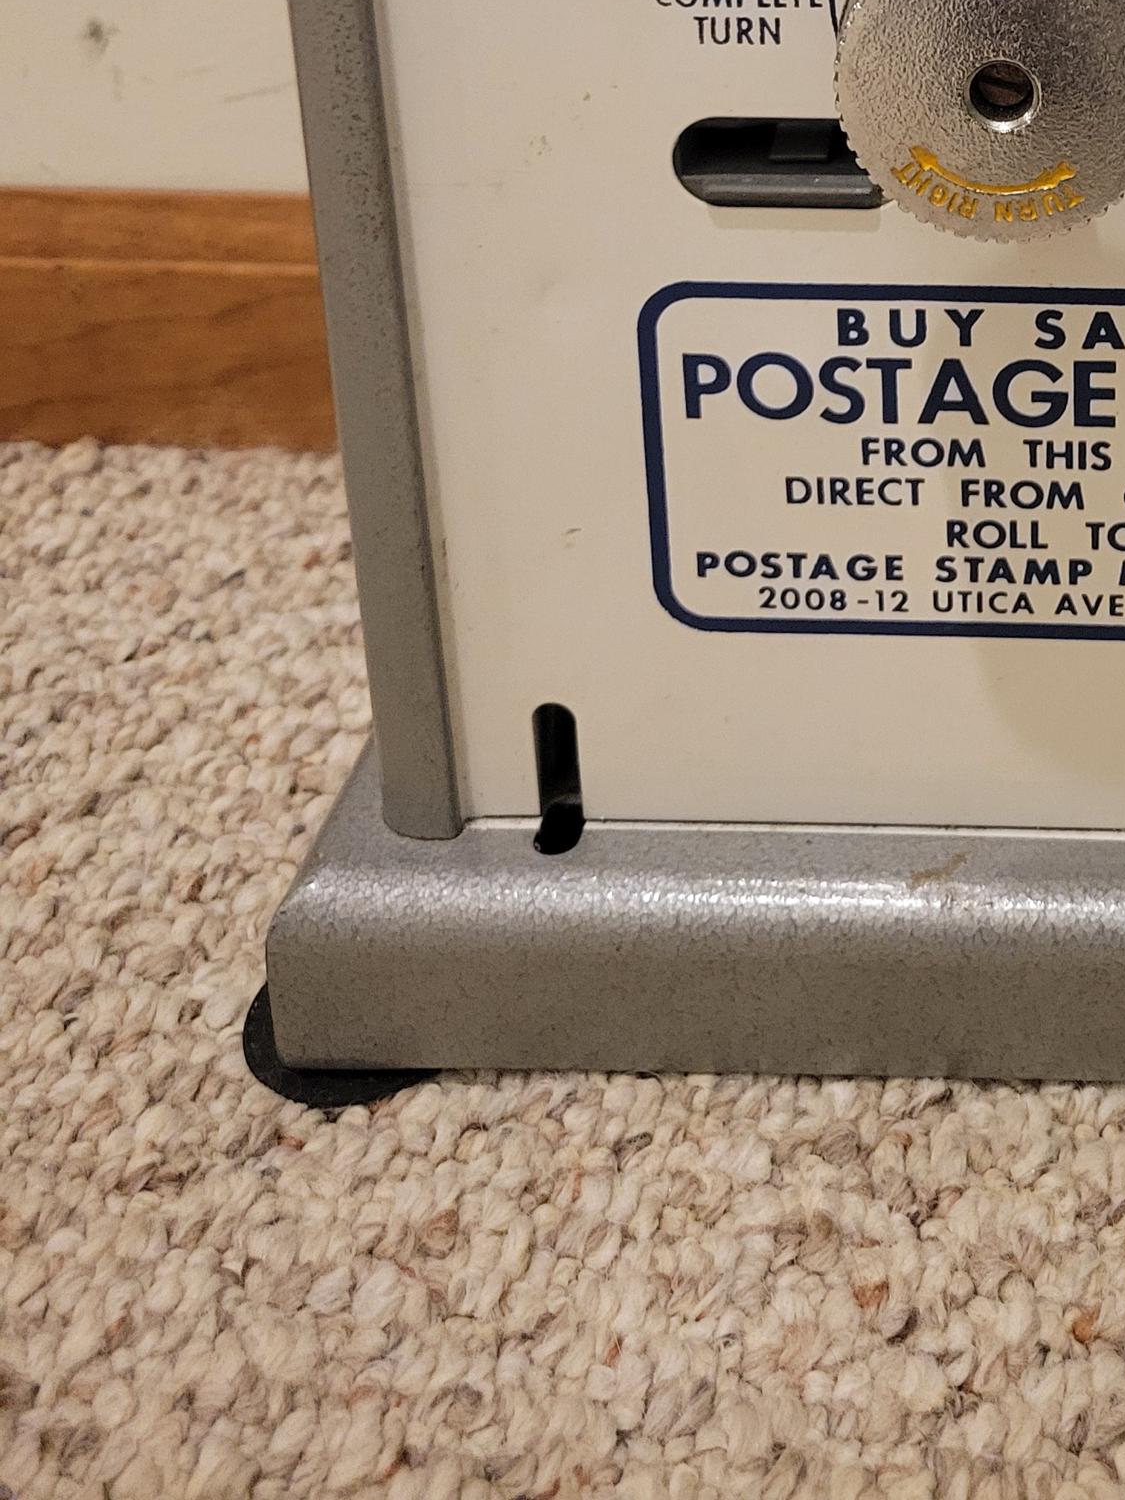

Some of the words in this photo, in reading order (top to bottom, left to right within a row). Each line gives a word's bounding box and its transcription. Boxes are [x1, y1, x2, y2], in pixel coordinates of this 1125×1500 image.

[693, 16, 780, 45] TURN
[890, 162, 979, 219] RIGHT
[995, 185, 1086, 222] TURN
[837, 308, 985, 348] BUY
[682, 352, 1116, 428] POSTAGE
[861, 437, 986, 468] FROM
[1023, 439, 1111, 471] THIS
[785, 476, 925, 506] DIRECT
[961, 479, 1084, 510] FROM
[947, 520, 1048, 549] ROLL
[696, 550, 903, 581] POSTAGE
[935, 556, 1092, 585] STAMP
[759, 586, 909, 612] 2008-12
[933, 590, 1035, 615] UTICA
